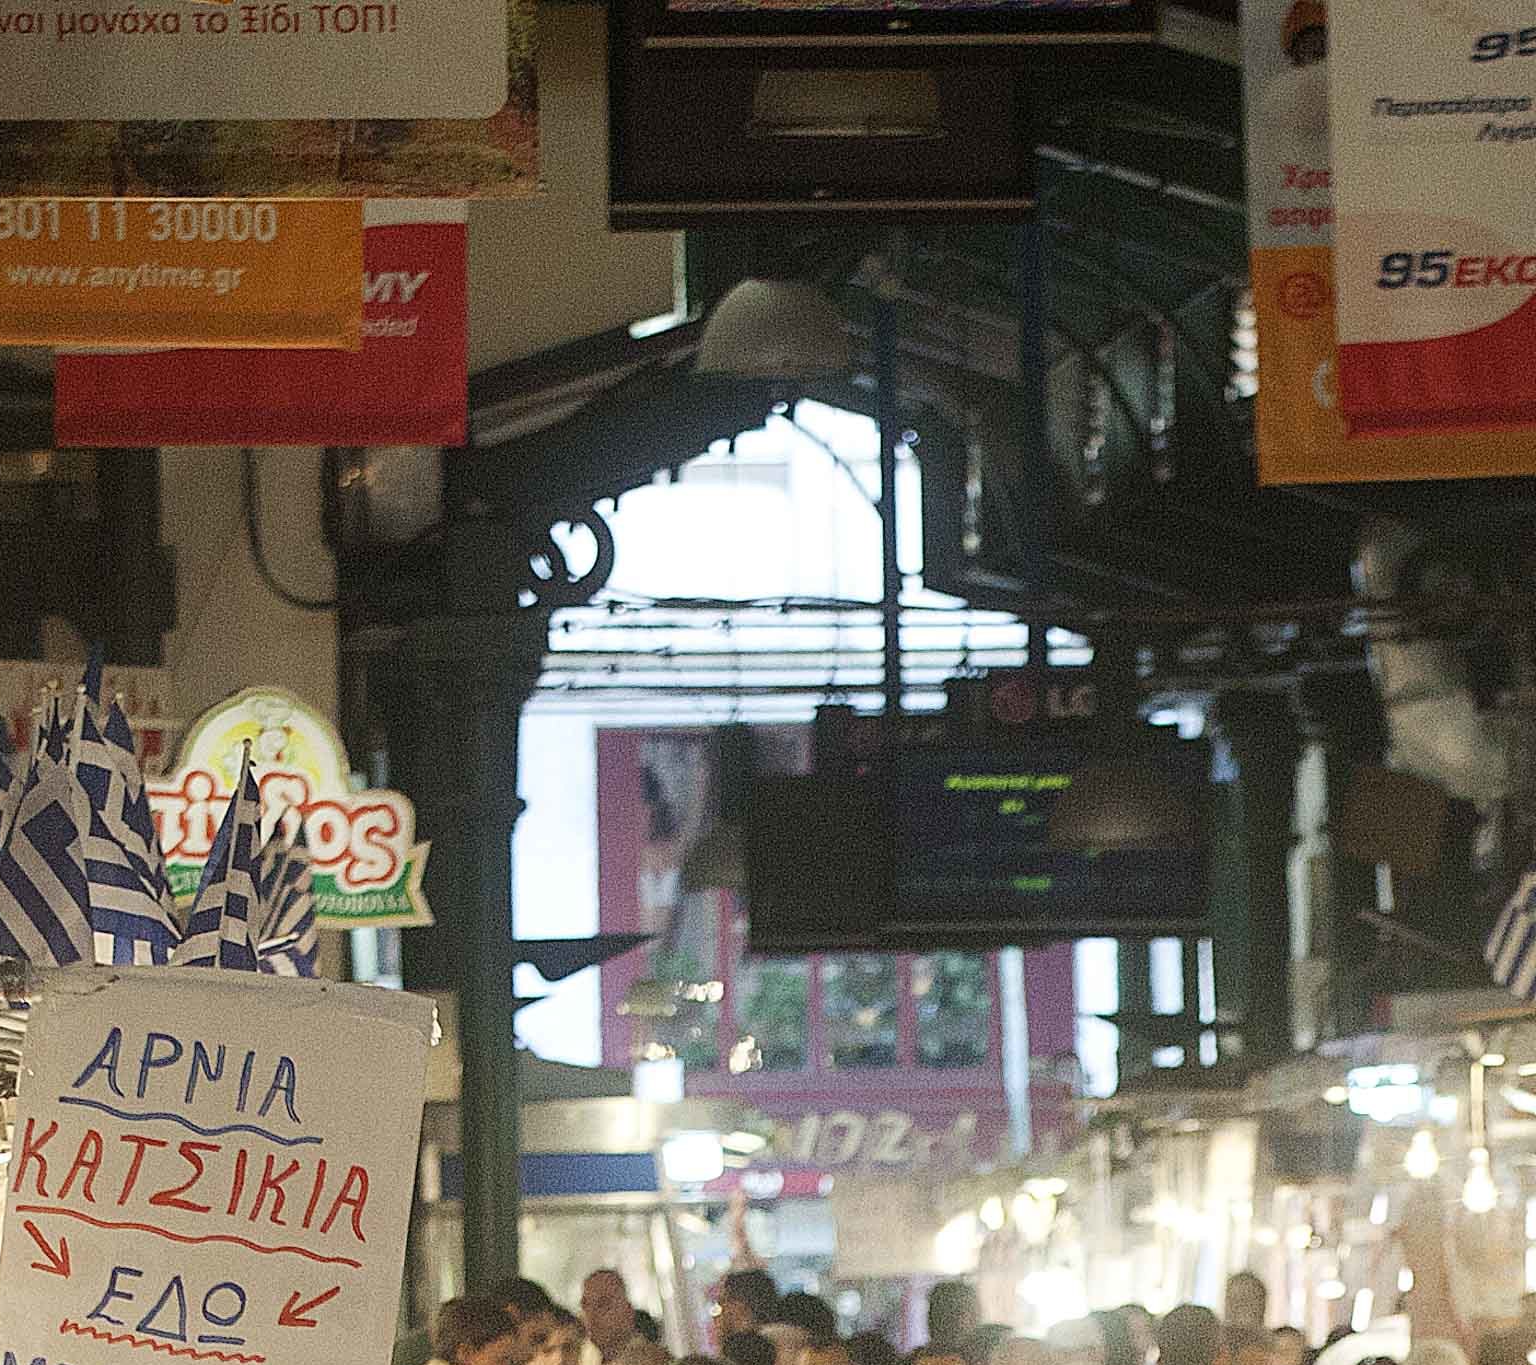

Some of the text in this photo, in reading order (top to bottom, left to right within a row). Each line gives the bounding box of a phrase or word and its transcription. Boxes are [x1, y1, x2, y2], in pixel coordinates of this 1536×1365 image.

[85, 202, 127, 242] 11
[147, 201, 279, 242] 30000
[5, 262, 244, 295] www.anytime.gr
[71, 1026, 303, 1124] ΑΡΝΙΑ
[12, 1117, 370, 1242] ΚΑΤΣΙΚΙΑ
[85, 1265, 248, 1344] ΕΔΩ
